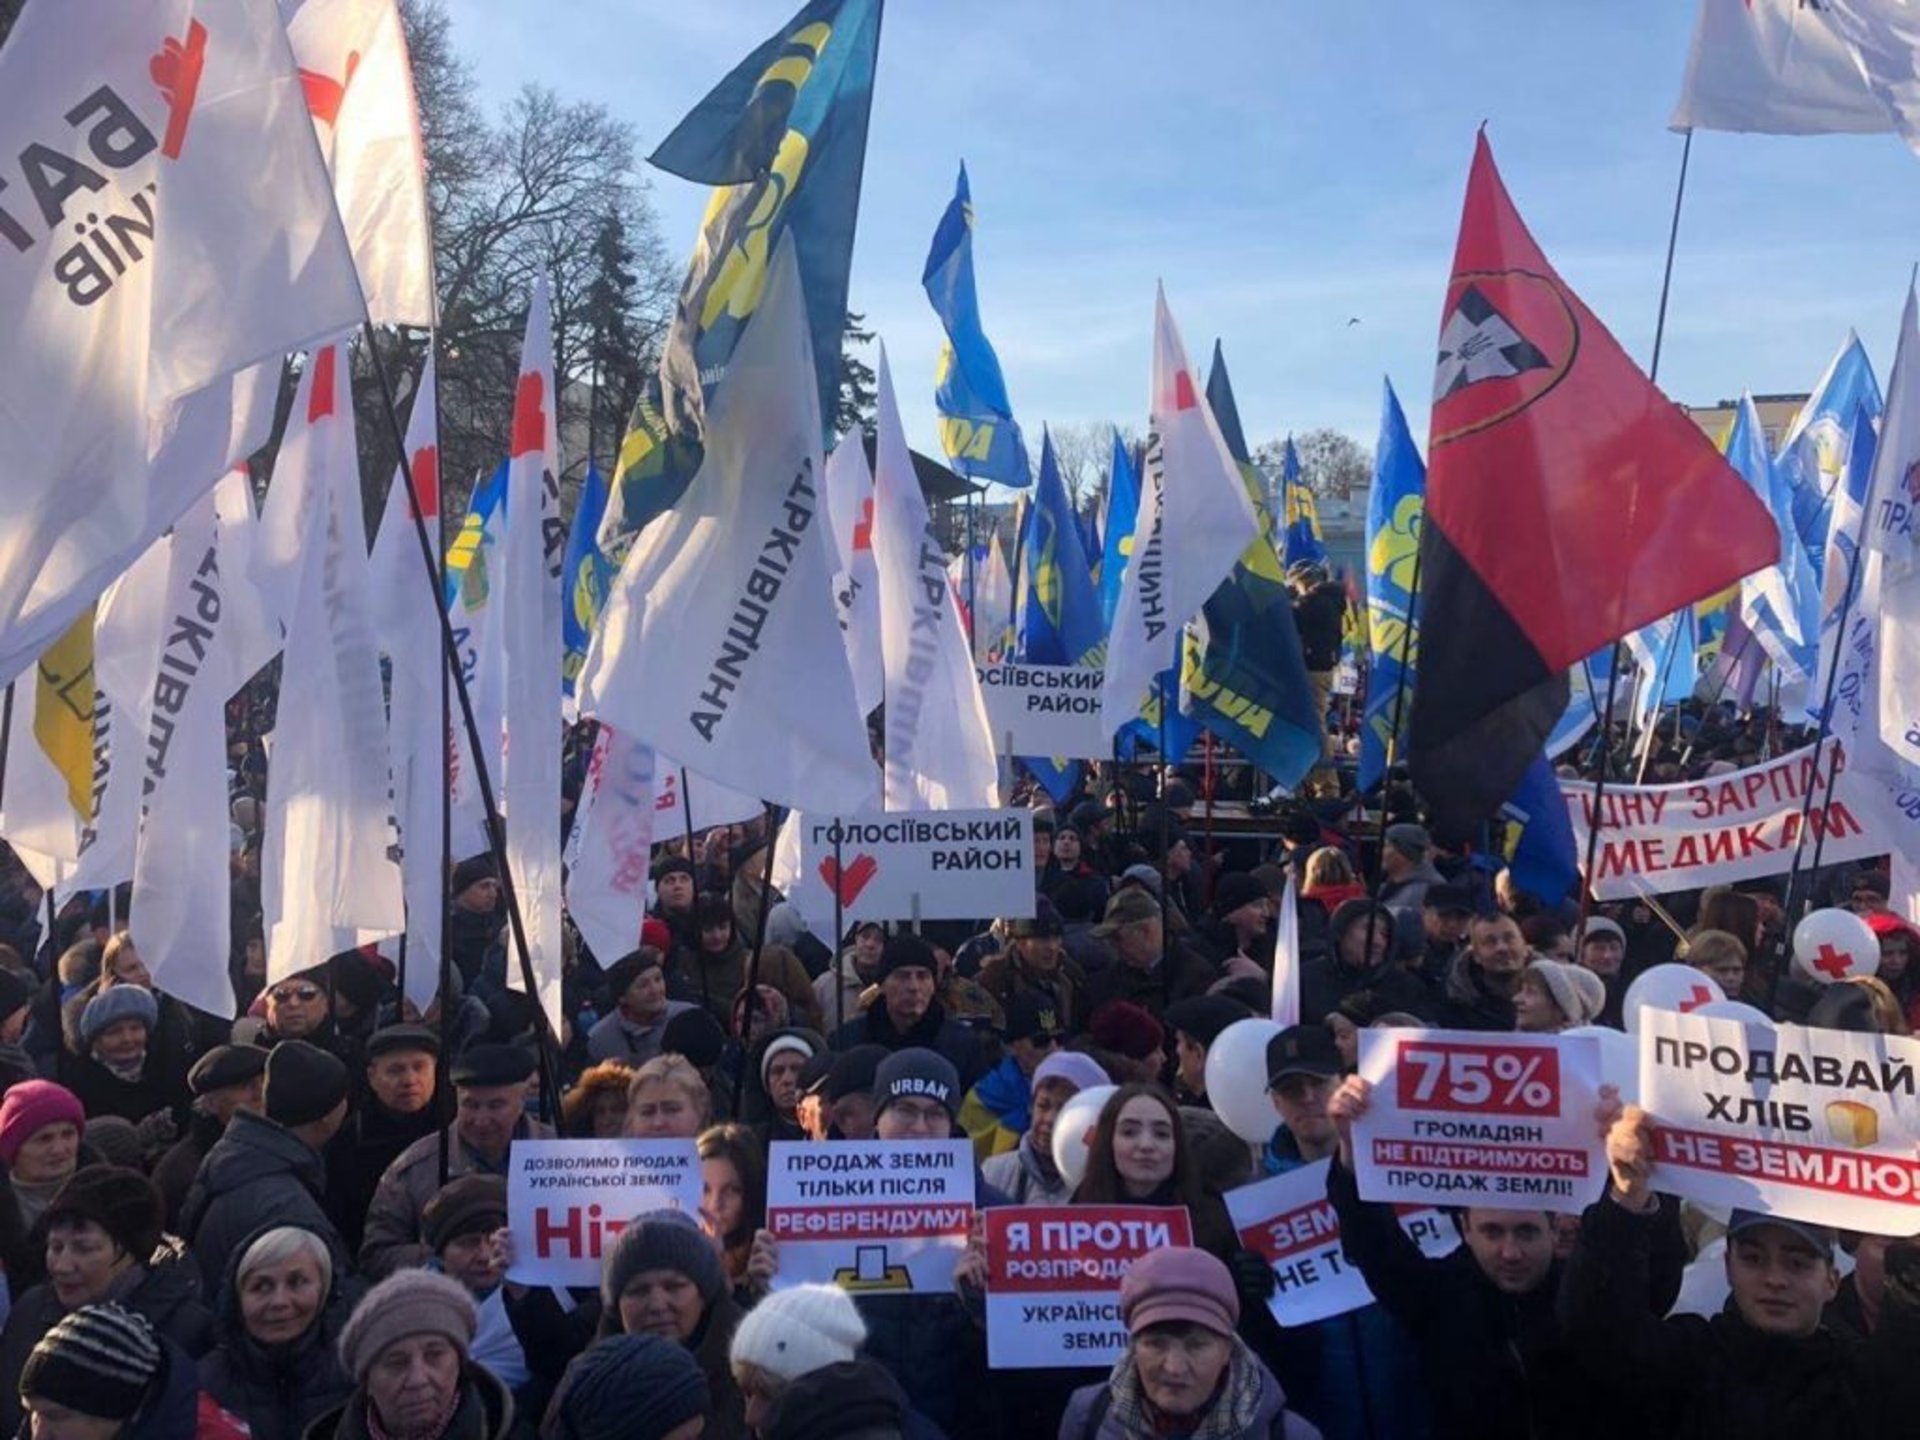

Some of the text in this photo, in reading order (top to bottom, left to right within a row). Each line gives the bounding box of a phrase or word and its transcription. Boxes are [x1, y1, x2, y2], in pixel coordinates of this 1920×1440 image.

[812, 817, 1021, 845] ГОЛОСІЇВСЬКИЙ
[1598, 801, 1863, 879] МЕДИКАМ
[931, 847, 1021, 870] РАЙОН
[1655, 1036, 1915, 1095] ПРОДАВАЙ
[891, 1078, 949, 1101] URBAN
[1404, 1050, 1551, 1108] 75%
[1703, 1092, 1812, 1132] ХЛІБ
[1413, 1120, 1542, 1143] ГРОМАДЯН
[524, 1156, 689, 1171] ДОЗВОЛИМО ПРОДАЖ
[787, 1152, 954, 1172] ПРОДАЖ ЗЕМЛІ
[1375, 1142, 1585, 1171] НЕ ПІДТРИМУЮТЬ
[1664, 1132, 1920, 1199] НЕ ЗЕМЛЮ!
[529, 1173, 681, 1188] УКРАЇНСЬКОЇ ЗЕМЛІ?
[797, 1178, 946, 1197] ТІЛЬКИ ПІСЛЯ
[1387, 1170, 1573, 1196] ПРОДАЖ ЗЕМЛІ!
[775, 1208, 967, 1233] РЕФЕРЕНДУМУ!
[1006, 1220, 1171, 1252] Я ПРОТИ
[1006, 1257, 1137, 1282] РОЗПРОДА
[1274, 1258, 1320, 1292] НЕ
